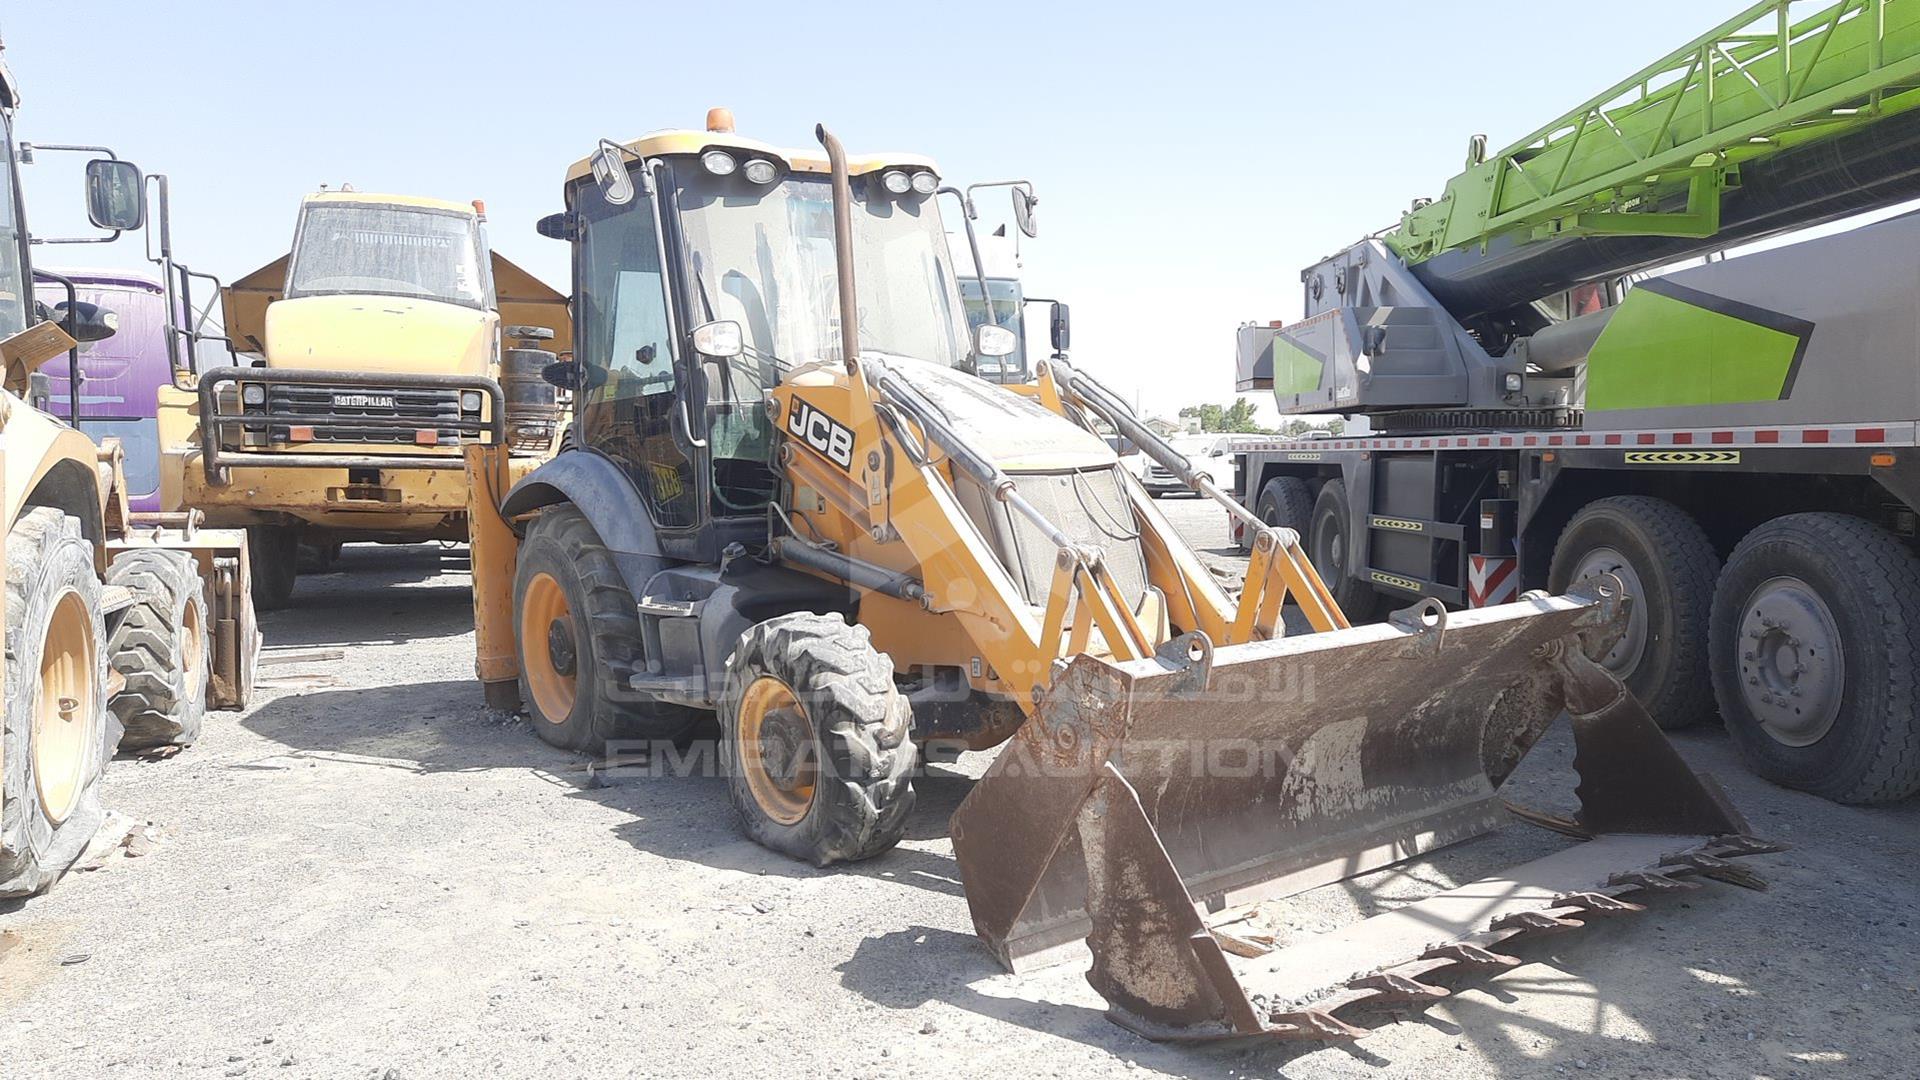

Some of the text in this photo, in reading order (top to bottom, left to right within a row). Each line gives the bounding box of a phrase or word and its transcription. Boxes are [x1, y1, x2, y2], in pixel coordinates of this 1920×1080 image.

[334, 395, 394, 408] CATERPILLAR
[789, 404, 852, 467] JCB
[655, 469, 682, 500] JCB
